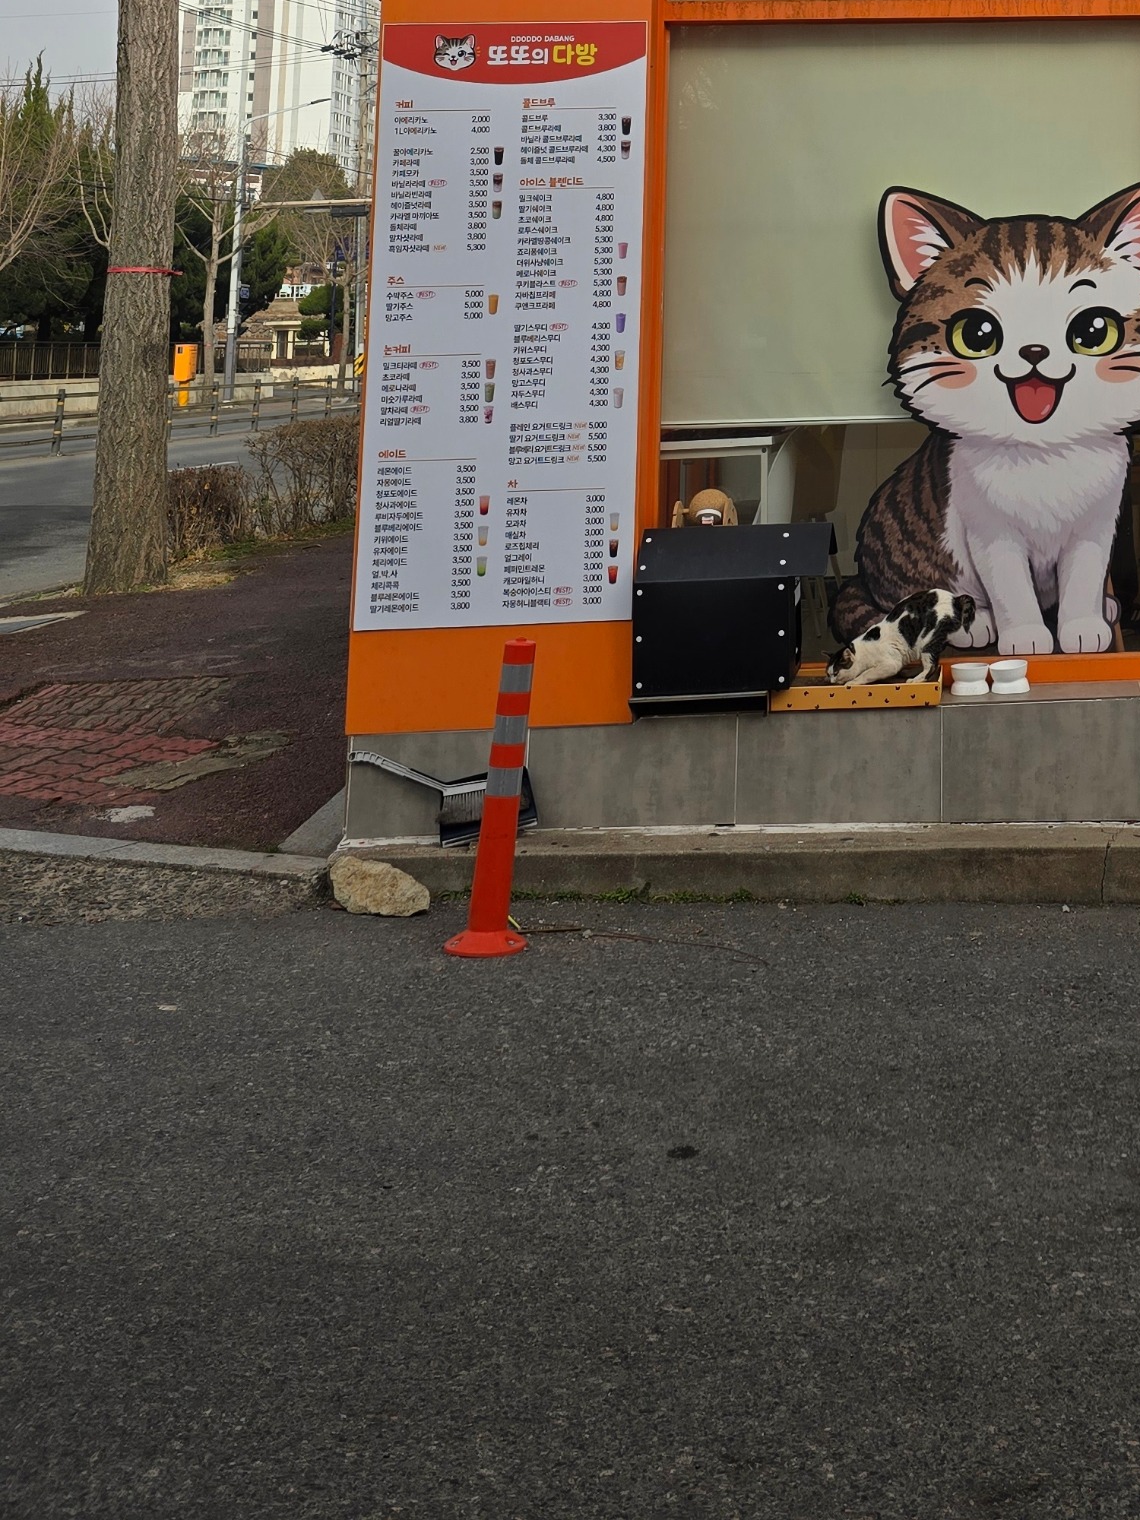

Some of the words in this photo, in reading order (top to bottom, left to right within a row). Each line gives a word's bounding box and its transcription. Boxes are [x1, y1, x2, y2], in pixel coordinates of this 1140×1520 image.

[487, 45, 548, 65] 또또의
[553, 44, 597, 65] 다방
[395, 100, 413, 108] 커피
[523, 98, 556, 108] 콜드브루
[521, 125, 561, 133] 콜드브루라떼
[543, 135, 582, 143] 콜드브루라떼
[393, 148, 433, 156] 꿀아메리카노
[471, 147, 489, 155] 2,500
[549, 145, 588, 153] 콜드브루라떼
[535, 156, 575, 164] 콜드브루라떼
[392, 180, 425, 188] 바닐라라떼
[520, 178, 546, 186] 아이스
[549, 177, 584, 187] 블렌디드
[391, 191, 432, 199] 바닐라빈라떼
[469, 190, 487, 198] 3,500
[391, 201, 431, 209] 헤이즐넛라떼
[519, 205, 552, 213] 딸기쉐이크
[468, 222, 486, 230] 3,800
[388, 245, 429, 253] 흑임자샷라떼
[388, 277, 404, 285] 주스
[386, 292, 414, 300] 수박주스
[465, 290, 484, 298] 5,000
[386, 303, 413, 311] 딸기주스
[385, 314, 413, 322] 망고주스
[514, 324, 547, 332] 딸기스무디
[592, 322, 610, 330] 4,300
[384, 345, 410, 355] 논커피
[513, 346, 547, 354] 키위스무디
[383, 362, 417, 370] 밀크티라떼
[462, 360, 480, 368] 3,500
[513, 357, 553, 365] 청포도스무디
[591, 355, 609, 363] 4,300
[382, 373, 410, 381] 초코라떼
[461, 371, 480, 379] 3,500
[512, 368, 552, 376] 청사과스무디
[590, 366, 609, 374] 4,300
[461, 382, 480, 390] 3,500
[512, 379, 545, 387] 망고스무디
[590, 377, 609, 385] 4,300
[511, 390, 545, 398] 자두스무디
[590, 388, 608, 396] 4,300
[381, 395, 422, 404] 미숫가루라떼
[511, 401, 538, 409] 배스무디
[589, 399, 608, 407] 4,300
[381, 406, 408, 415] 말차라떼
[380, 417, 421, 426] 리얼딸기라떼
[459, 416, 478, 424] 3,800
[510, 423, 530, 432] 플레인
[532, 422, 572, 430] 요거트드링크
[509, 435, 523, 443] 딸기
[525, 434, 565, 442] 요거트드링크
[588, 433, 607, 441] 5,500
[378, 449, 406, 458] 에이드
[588, 455, 606, 463] 5,500
[377, 466, 412, 476] 레몬에이드
[457, 465, 476, 473] 3,500
[377, 478, 412, 486] 자몽에이드
[456, 477, 475, 485] 3,500
[508, 480, 518, 488] 차
[376, 490, 417, 498] 청포도에이드
[455, 488, 475, 496] 3,500
[375, 501, 417, 510] 청사과에이드
[455, 499, 474, 507] 3,500
[507, 497, 527, 505] 레몬차
[454, 511, 474, 519] 3,500
[506, 508, 527, 516] 유자차
[586, 506, 604, 514] 3,000
[374, 524, 423, 532] 블루베리에이드
[454, 522, 473, 530] 3,500
[506, 520, 526, 528] 모과차
[585, 517, 604, 525] 3,000
[374, 535, 408, 544] 키위에이드
[454, 533, 473, 541] 3,500
[505, 531, 526, 539] 매실차
[585, 529, 604, 537] 3,000
[584, 540, 603, 548] 3,000
[373, 547, 408, 555] 유자에이드
[372, 558, 407, 567] 체리에이드
[452, 556, 472, 564] 3,500
[504, 553, 532, 562] 얼그레이
[584, 551, 603, 559] 3,000
[504, 565, 545, 573] 페퍼민트레몬
[584, 563, 603, 571] 3,000
[451, 579, 471, 587] 3,500
[503, 576, 544, 585] 캐모마일허니
[583, 574, 602, 582] 3,000
[503, 587, 551, 596] 복숭아아이스티
[583, 585, 602, 593] 3,000
[371, 593, 420, 602] 블루레몬에이드
[451, 591, 470, 599] 3,500
[583, 597, 601, 605] 3,000
[370, 604, 419, 614] 딸기레몬에이드
[451, 602, 470, 610] 3,800
